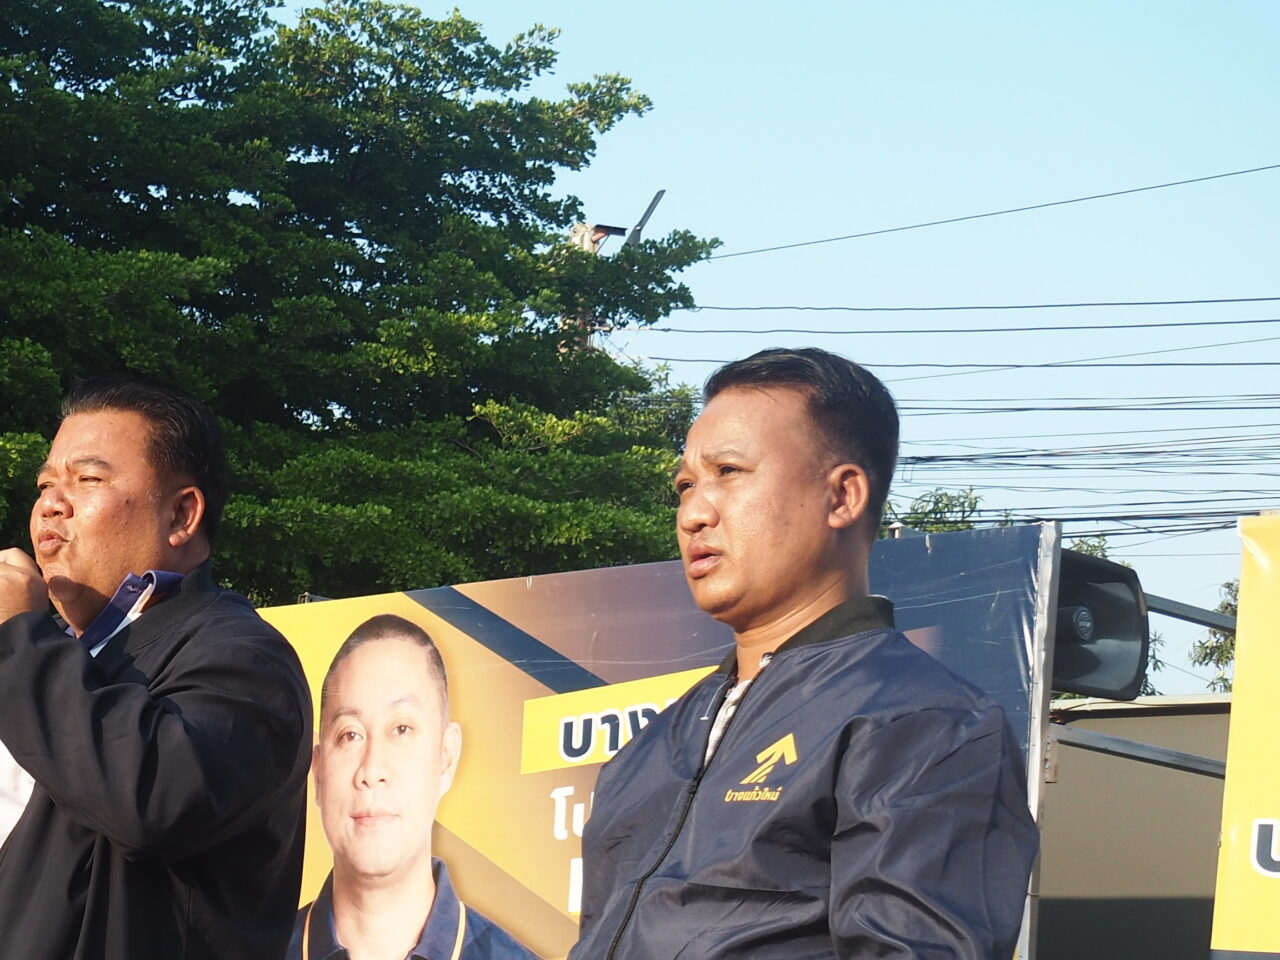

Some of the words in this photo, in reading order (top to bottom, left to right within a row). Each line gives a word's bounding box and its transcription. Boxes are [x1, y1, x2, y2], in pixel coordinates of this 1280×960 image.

[724, 786, 783, 802] บางแก้วใหม่
